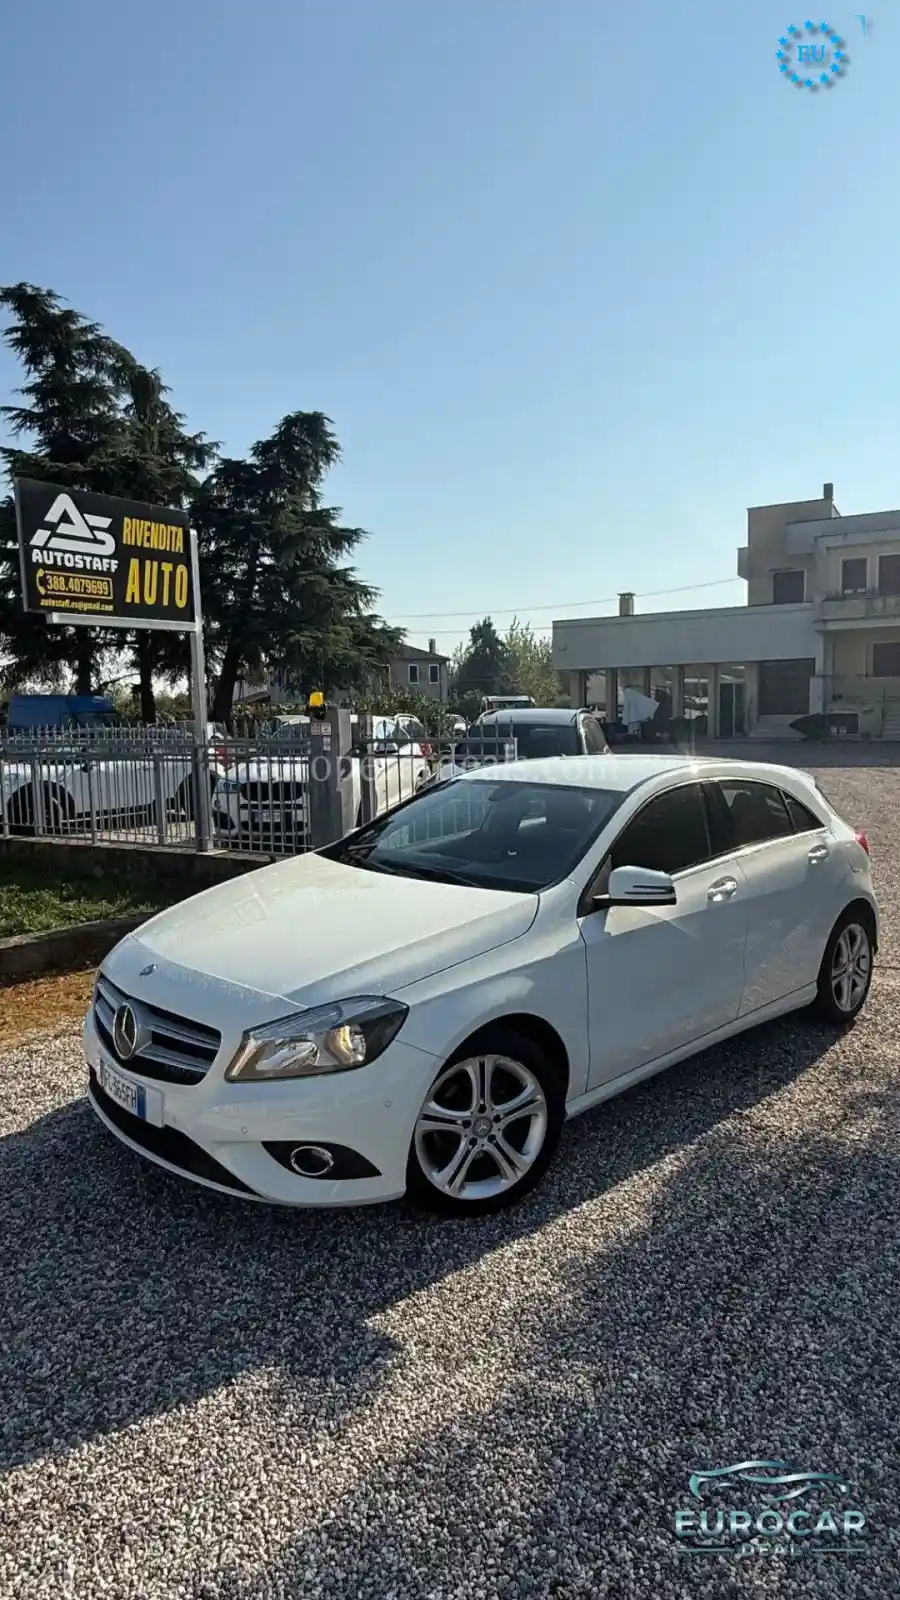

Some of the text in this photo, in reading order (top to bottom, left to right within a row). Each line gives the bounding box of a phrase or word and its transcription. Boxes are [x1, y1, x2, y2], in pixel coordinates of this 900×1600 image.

[122, 516, 184, 553] RIVENDITA
[31, 548, 119, 573] AUTOSTAFF
[45, 575, 109, 595] 388.4079699
[125, 558, 188, 608] AUTO
